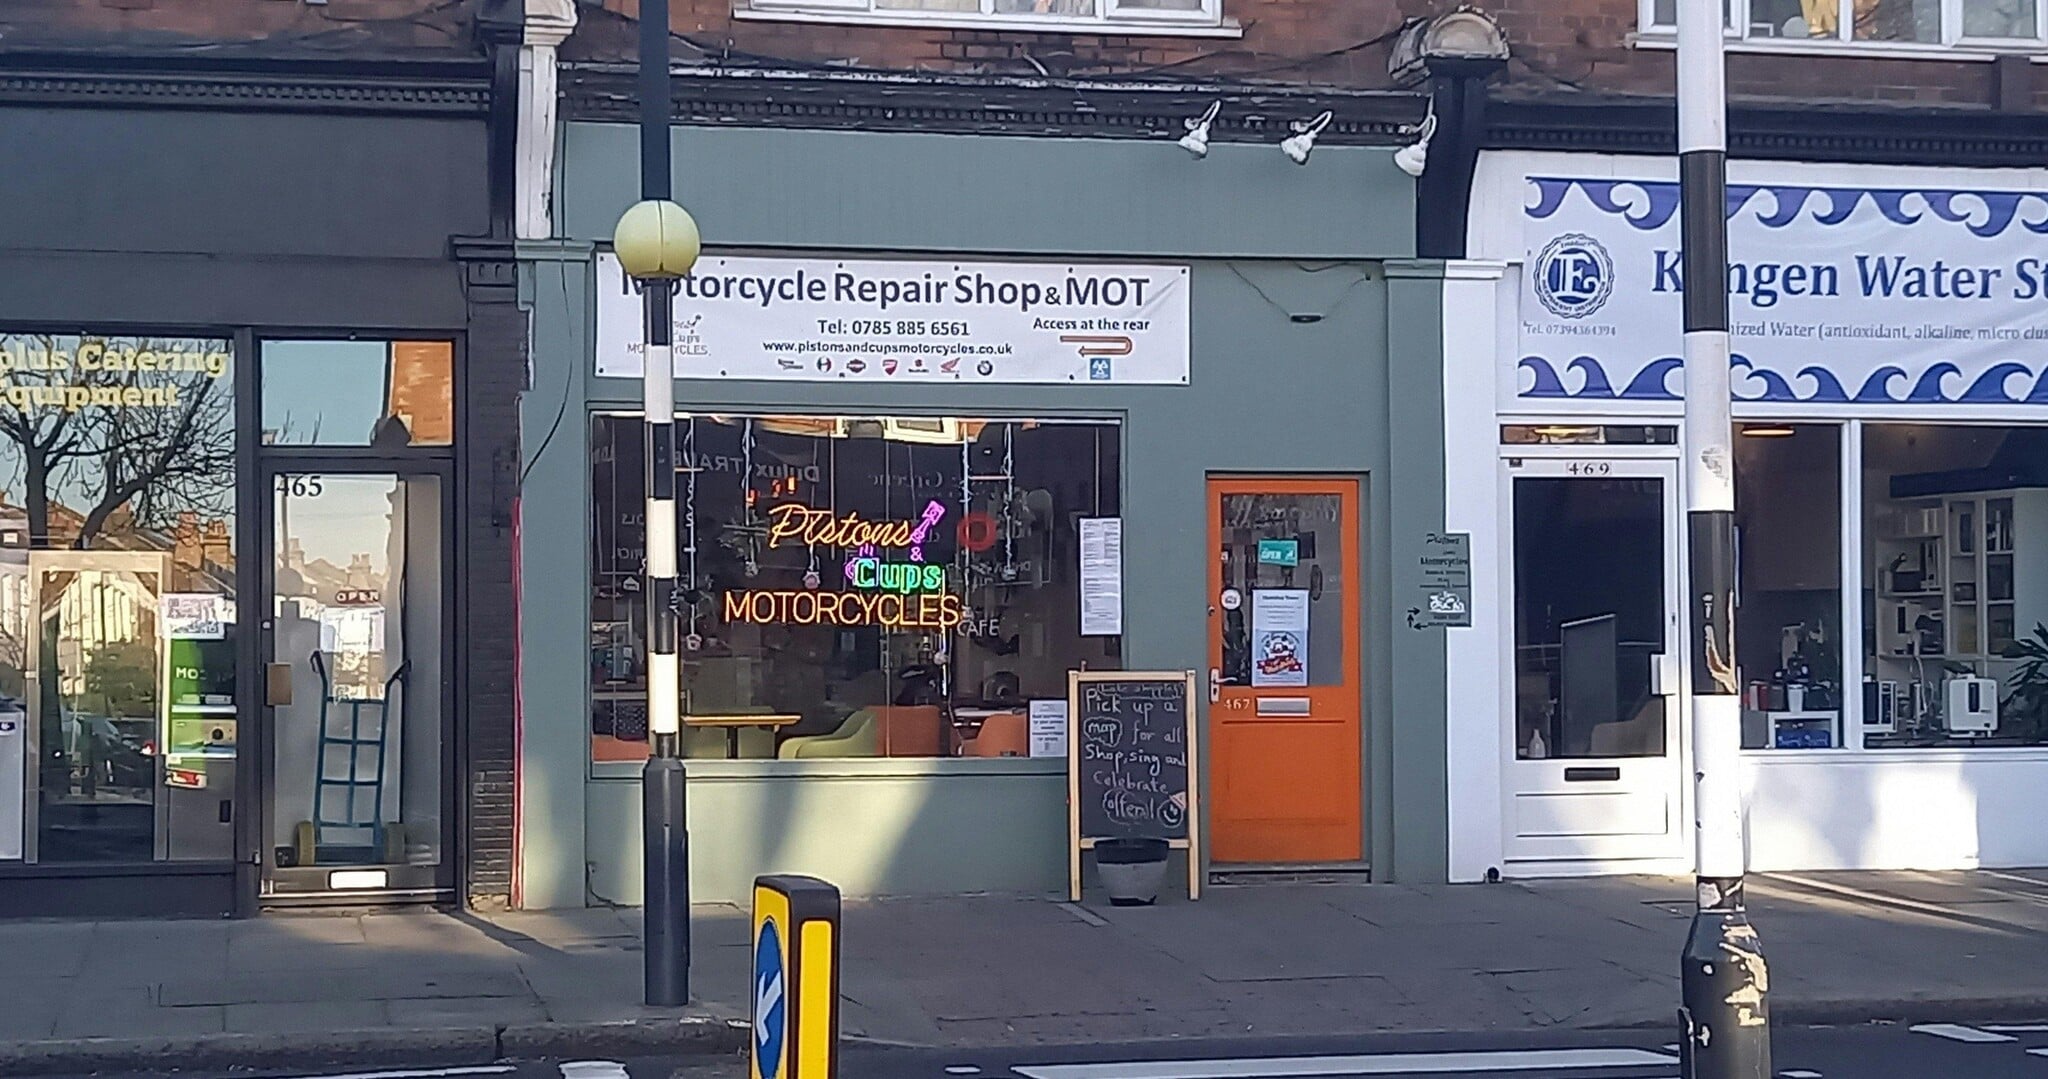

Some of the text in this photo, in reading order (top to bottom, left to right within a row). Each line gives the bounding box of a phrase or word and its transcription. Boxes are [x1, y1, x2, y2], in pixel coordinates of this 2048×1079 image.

[1652, 250, 1840, 307] Kngen
[1856, 254, 2002, 299] Water
[835, 271, 948, 310] Repair
[954, 272, 1041, 312] Shop
[1045, 285, 1062, 306] &
[1066, 276, 1150, 307] MOT
[817, 319, 970, 337] Tel: 0785 885 6561
[1033, 317, 1150, 332] Access at the rear
[1770, 321, 1814, 338] Water
[1978, 325, 2020, 340] micro
[78, 343, 229, 377] Catering
[763, 340, 1013, 357] www.pistonsandcupsmotorcycles.co.uk
[0, 379, 181, 413] quipment
[1569, 462, 1610, 476] 469
[276, 475, 322, 497] 465
[769, 503, 913, 549] Pistons
[909, 546, 924, 562] &
[854, 558, 942, 595] Cups
[724, 591, 959, 626] MOTORCYCLES
[957, 619, 999, 638] CAFE
[1085, 687, 1178, 726] Pick up a
[1088, 722, 1117, 745] map
[1132, 719, 1156, 746] for
[1163, 727, 1181, 743] all
[1164, 751, 1187, 767] and
